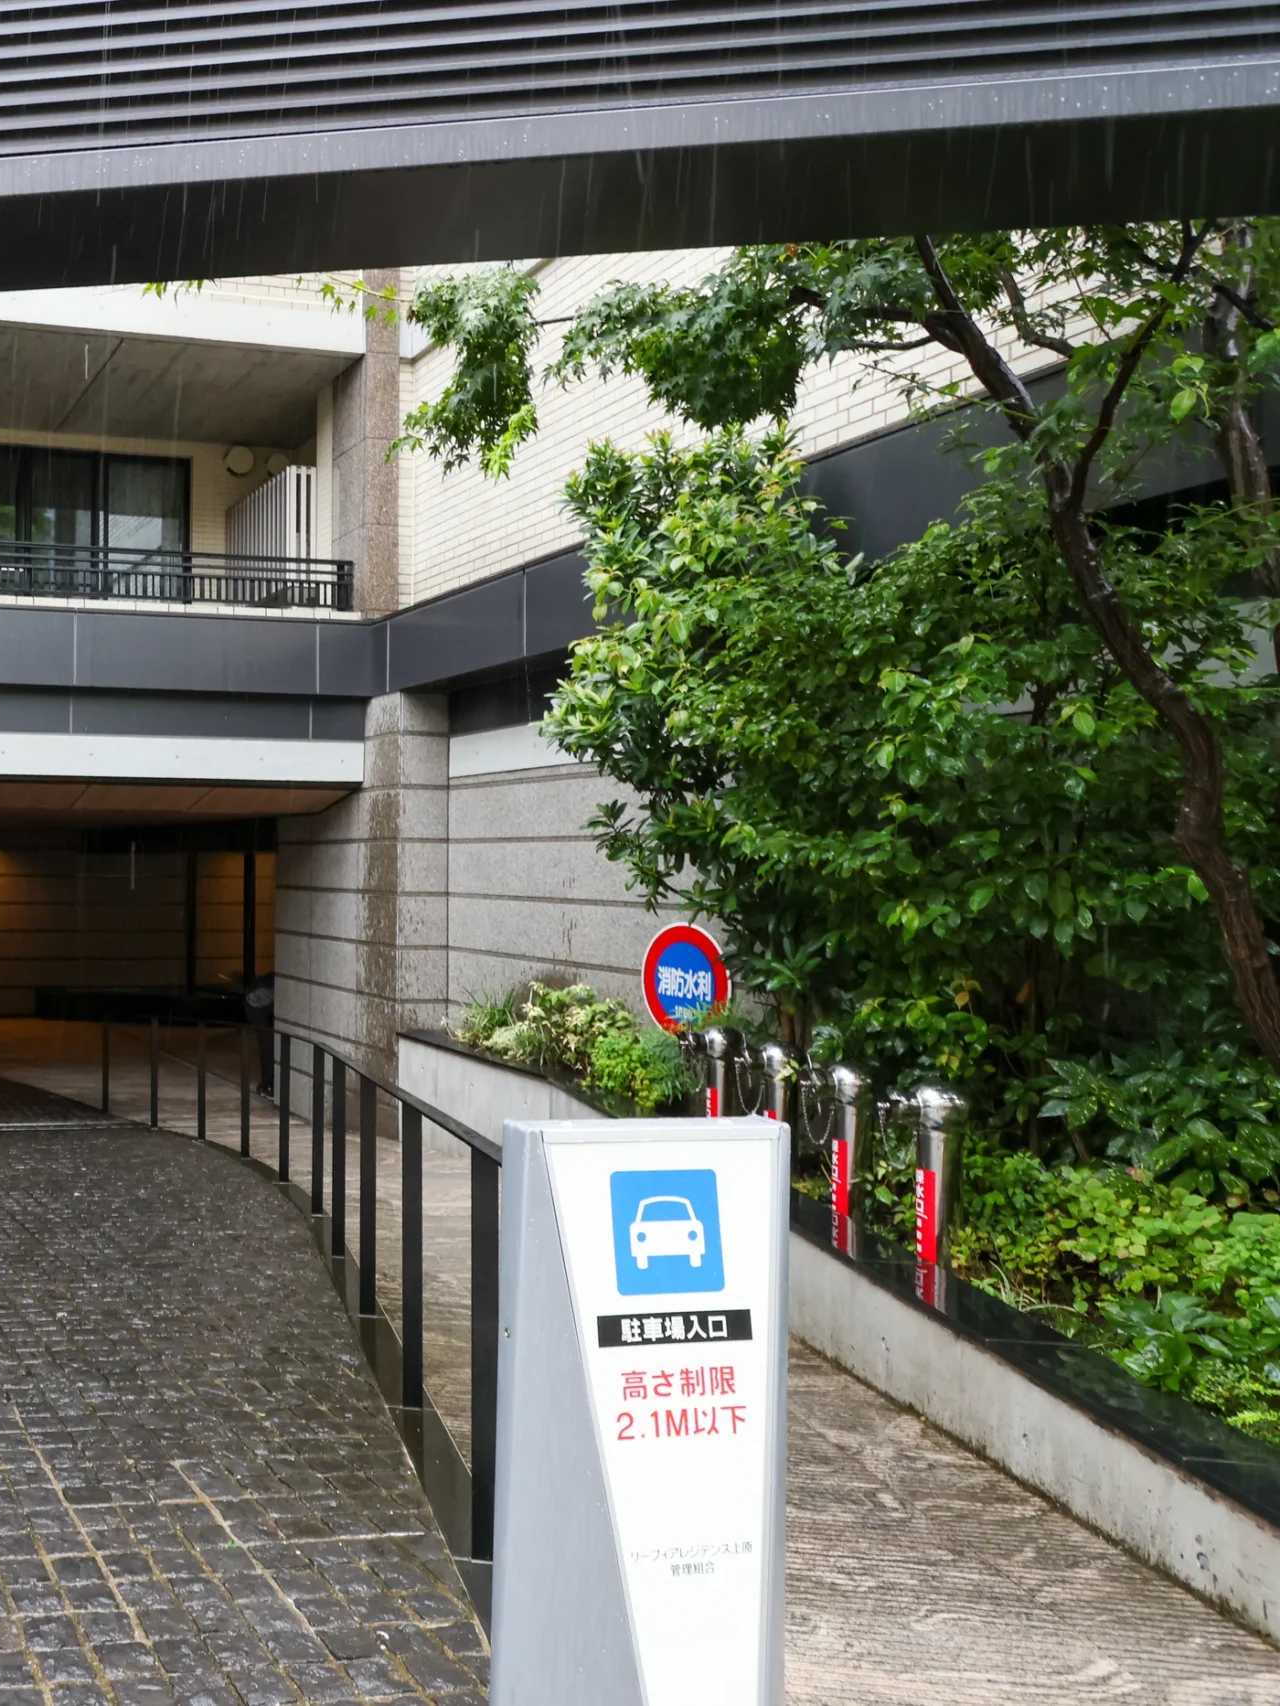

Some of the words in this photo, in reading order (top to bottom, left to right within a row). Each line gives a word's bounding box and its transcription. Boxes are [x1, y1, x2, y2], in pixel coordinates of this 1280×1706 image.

[657, 965, 712, 1002] 消防水利
[621, 1315, 728, 1343] 駐車場入口
[621, 1366, 736, 1401] 高さ制限
[616, 1406, 746, 1441] 2.1M以下
[670, 1561, 715, 1577] 管理組合
